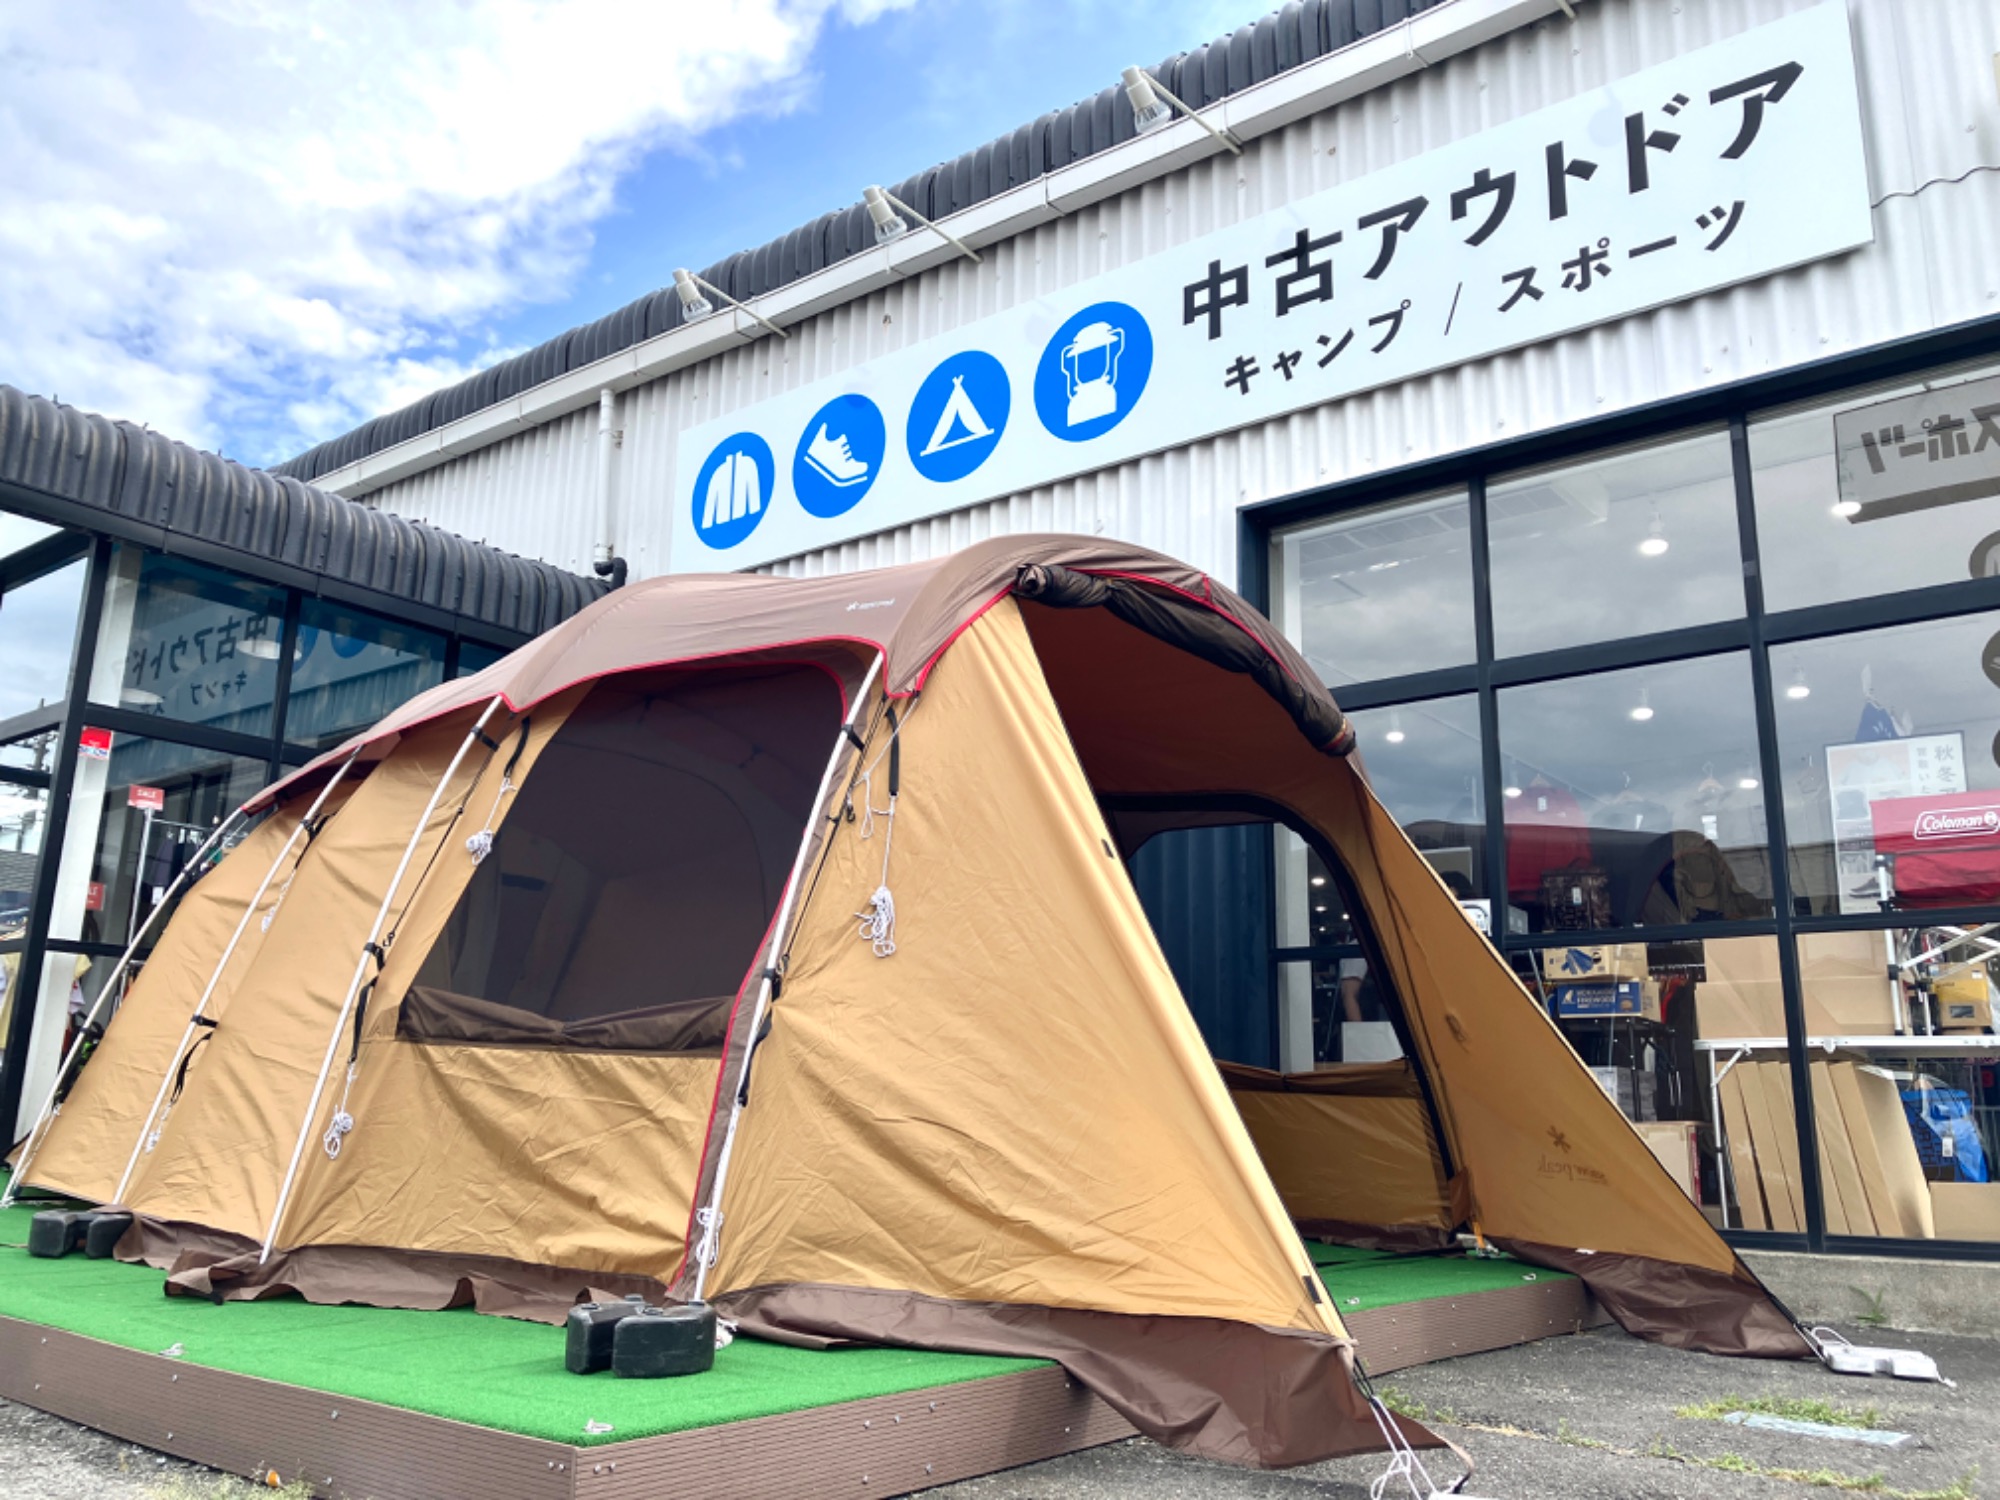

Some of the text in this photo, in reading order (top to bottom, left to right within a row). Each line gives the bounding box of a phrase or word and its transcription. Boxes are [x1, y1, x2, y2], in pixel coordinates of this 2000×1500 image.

[1182, 61, 1804, 341] 中古アウトドア
[1224, 299, 1412, 395] キャンプ
[1497, 200, 1746, 313] スポーツ
[1922, 814, 1983, 832] Coleman
